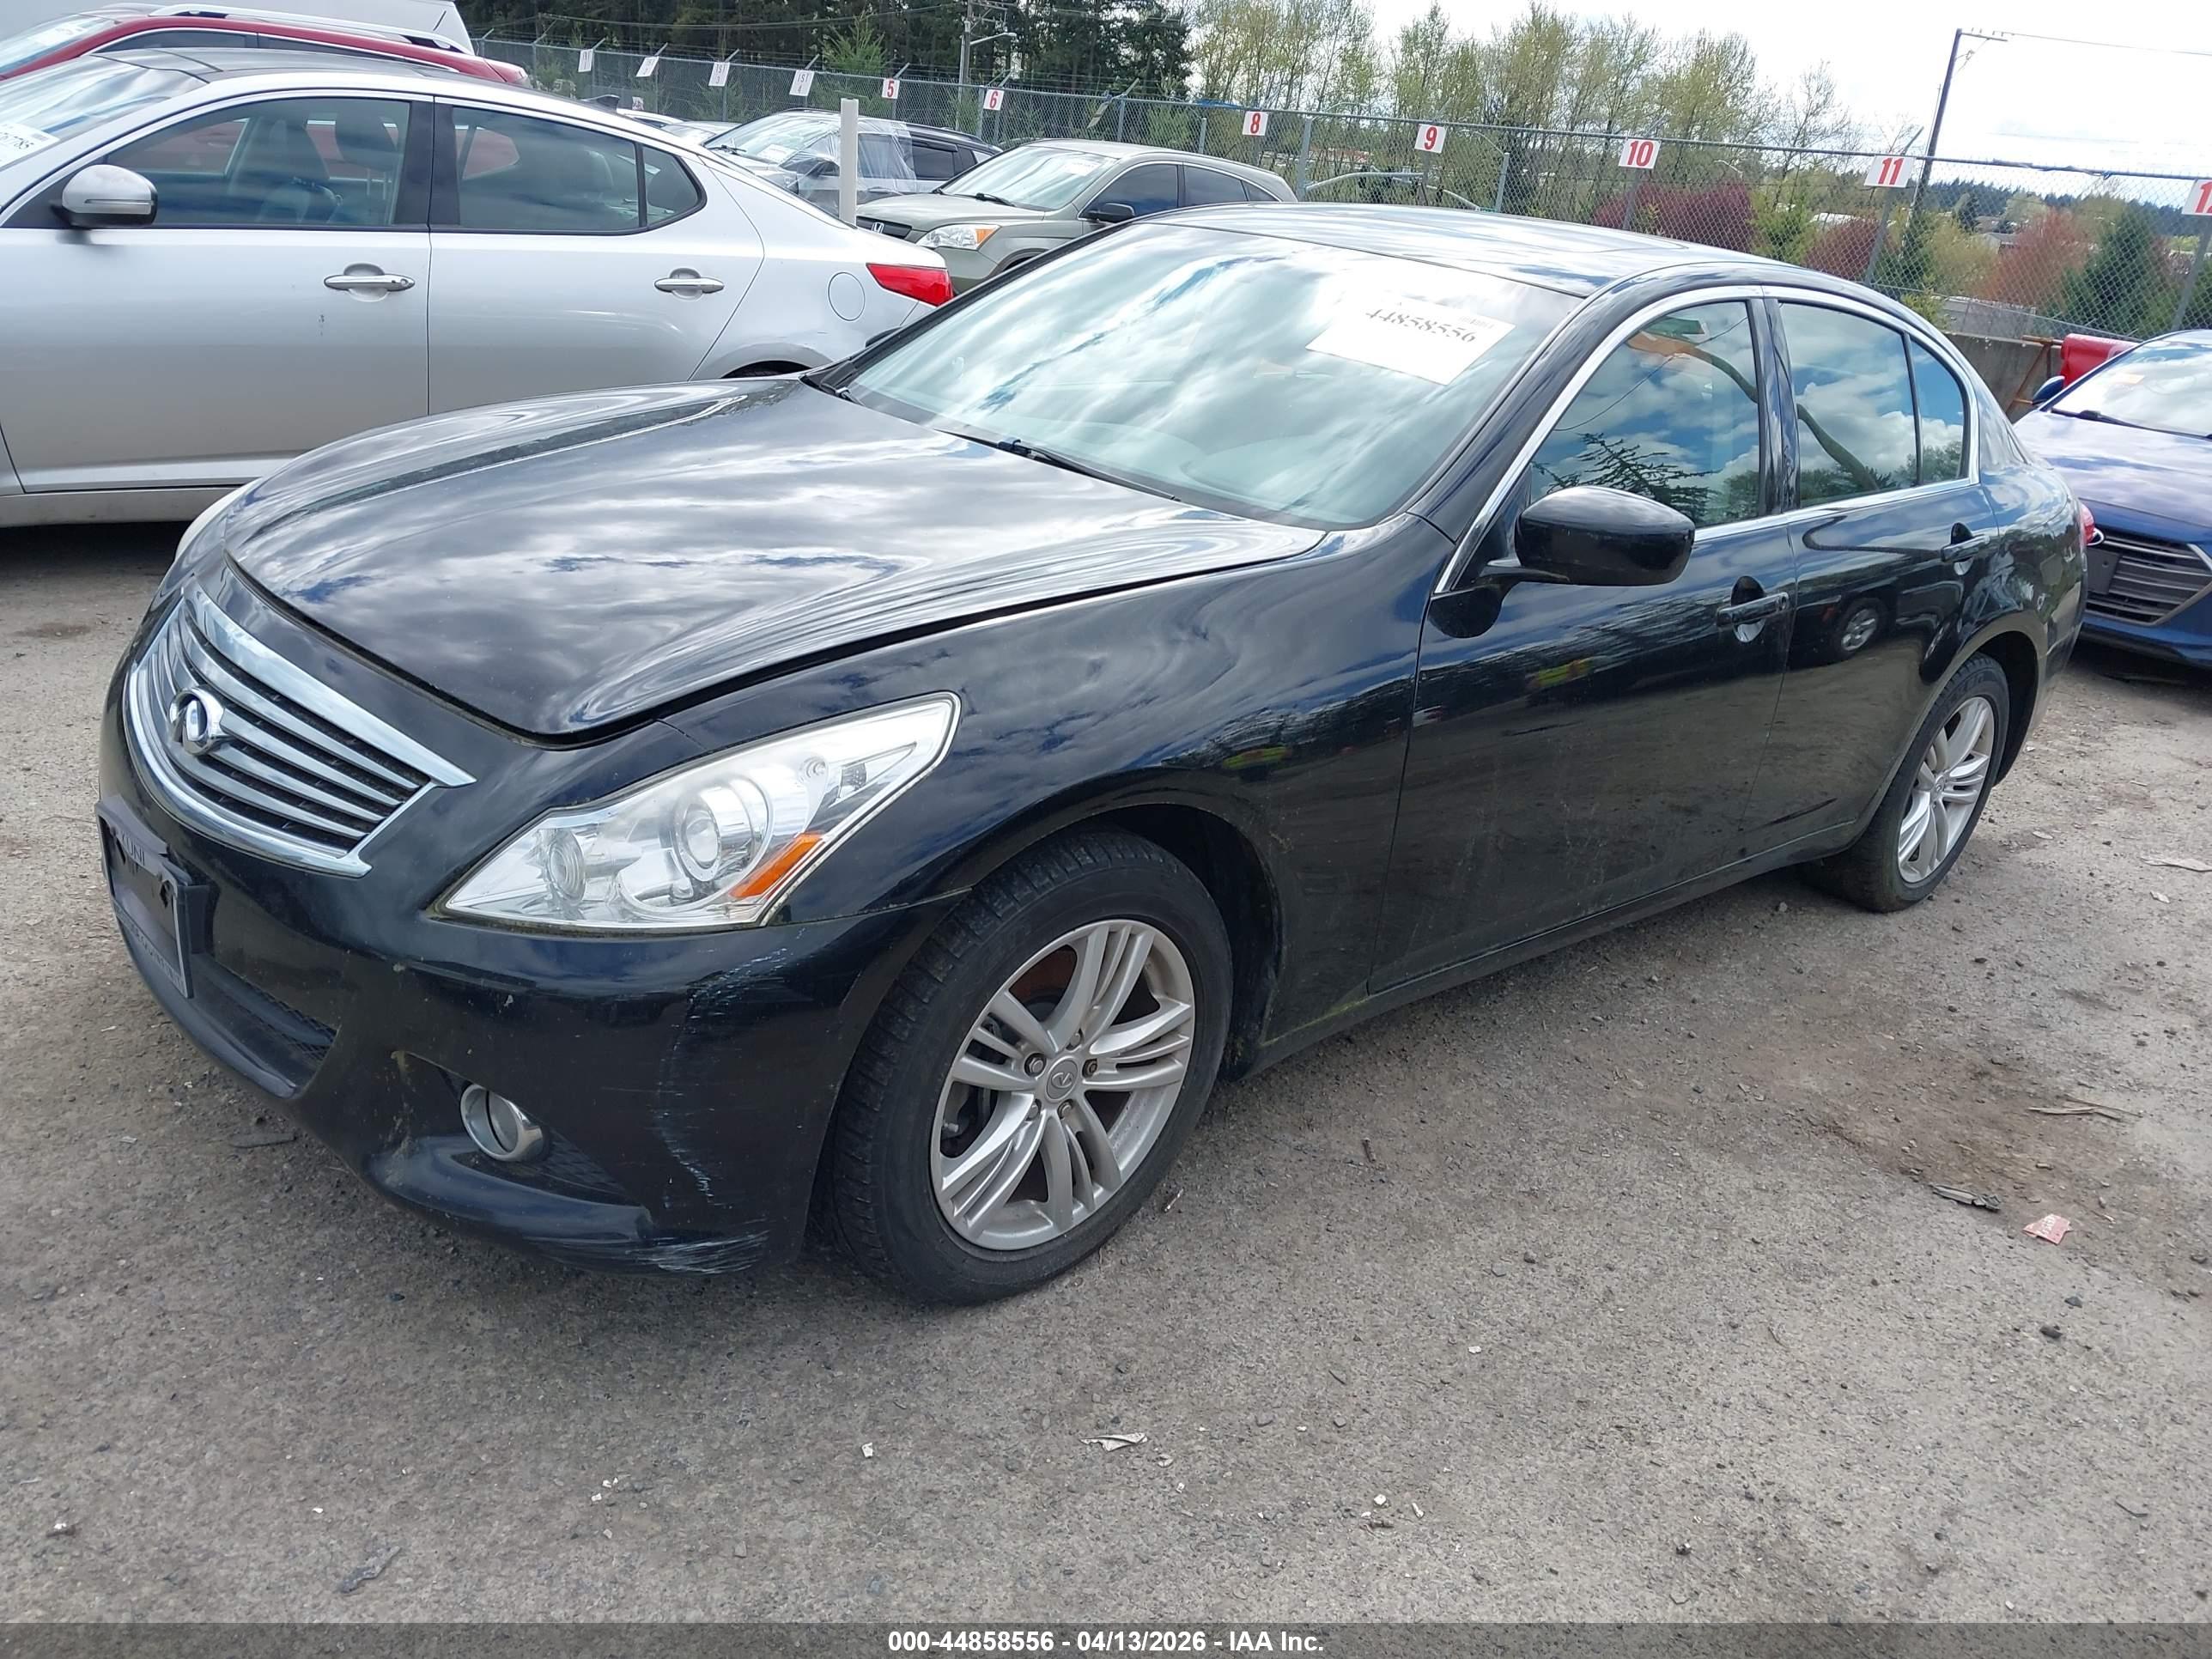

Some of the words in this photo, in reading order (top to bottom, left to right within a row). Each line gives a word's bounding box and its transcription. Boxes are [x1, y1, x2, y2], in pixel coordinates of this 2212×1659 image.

[887, 80, 895, 98] 5
[989, 91, 999, 109] 6
[1250, 112, 1261, 134] 8
[1424, 126, 1437, 150] 9
[1627, 140, 1654, 167] 10
[1878, 157, 1905, 185] 11
[2195, 181, 2212, 214] 1
[1364, 308, 1477, 343] 44858556
